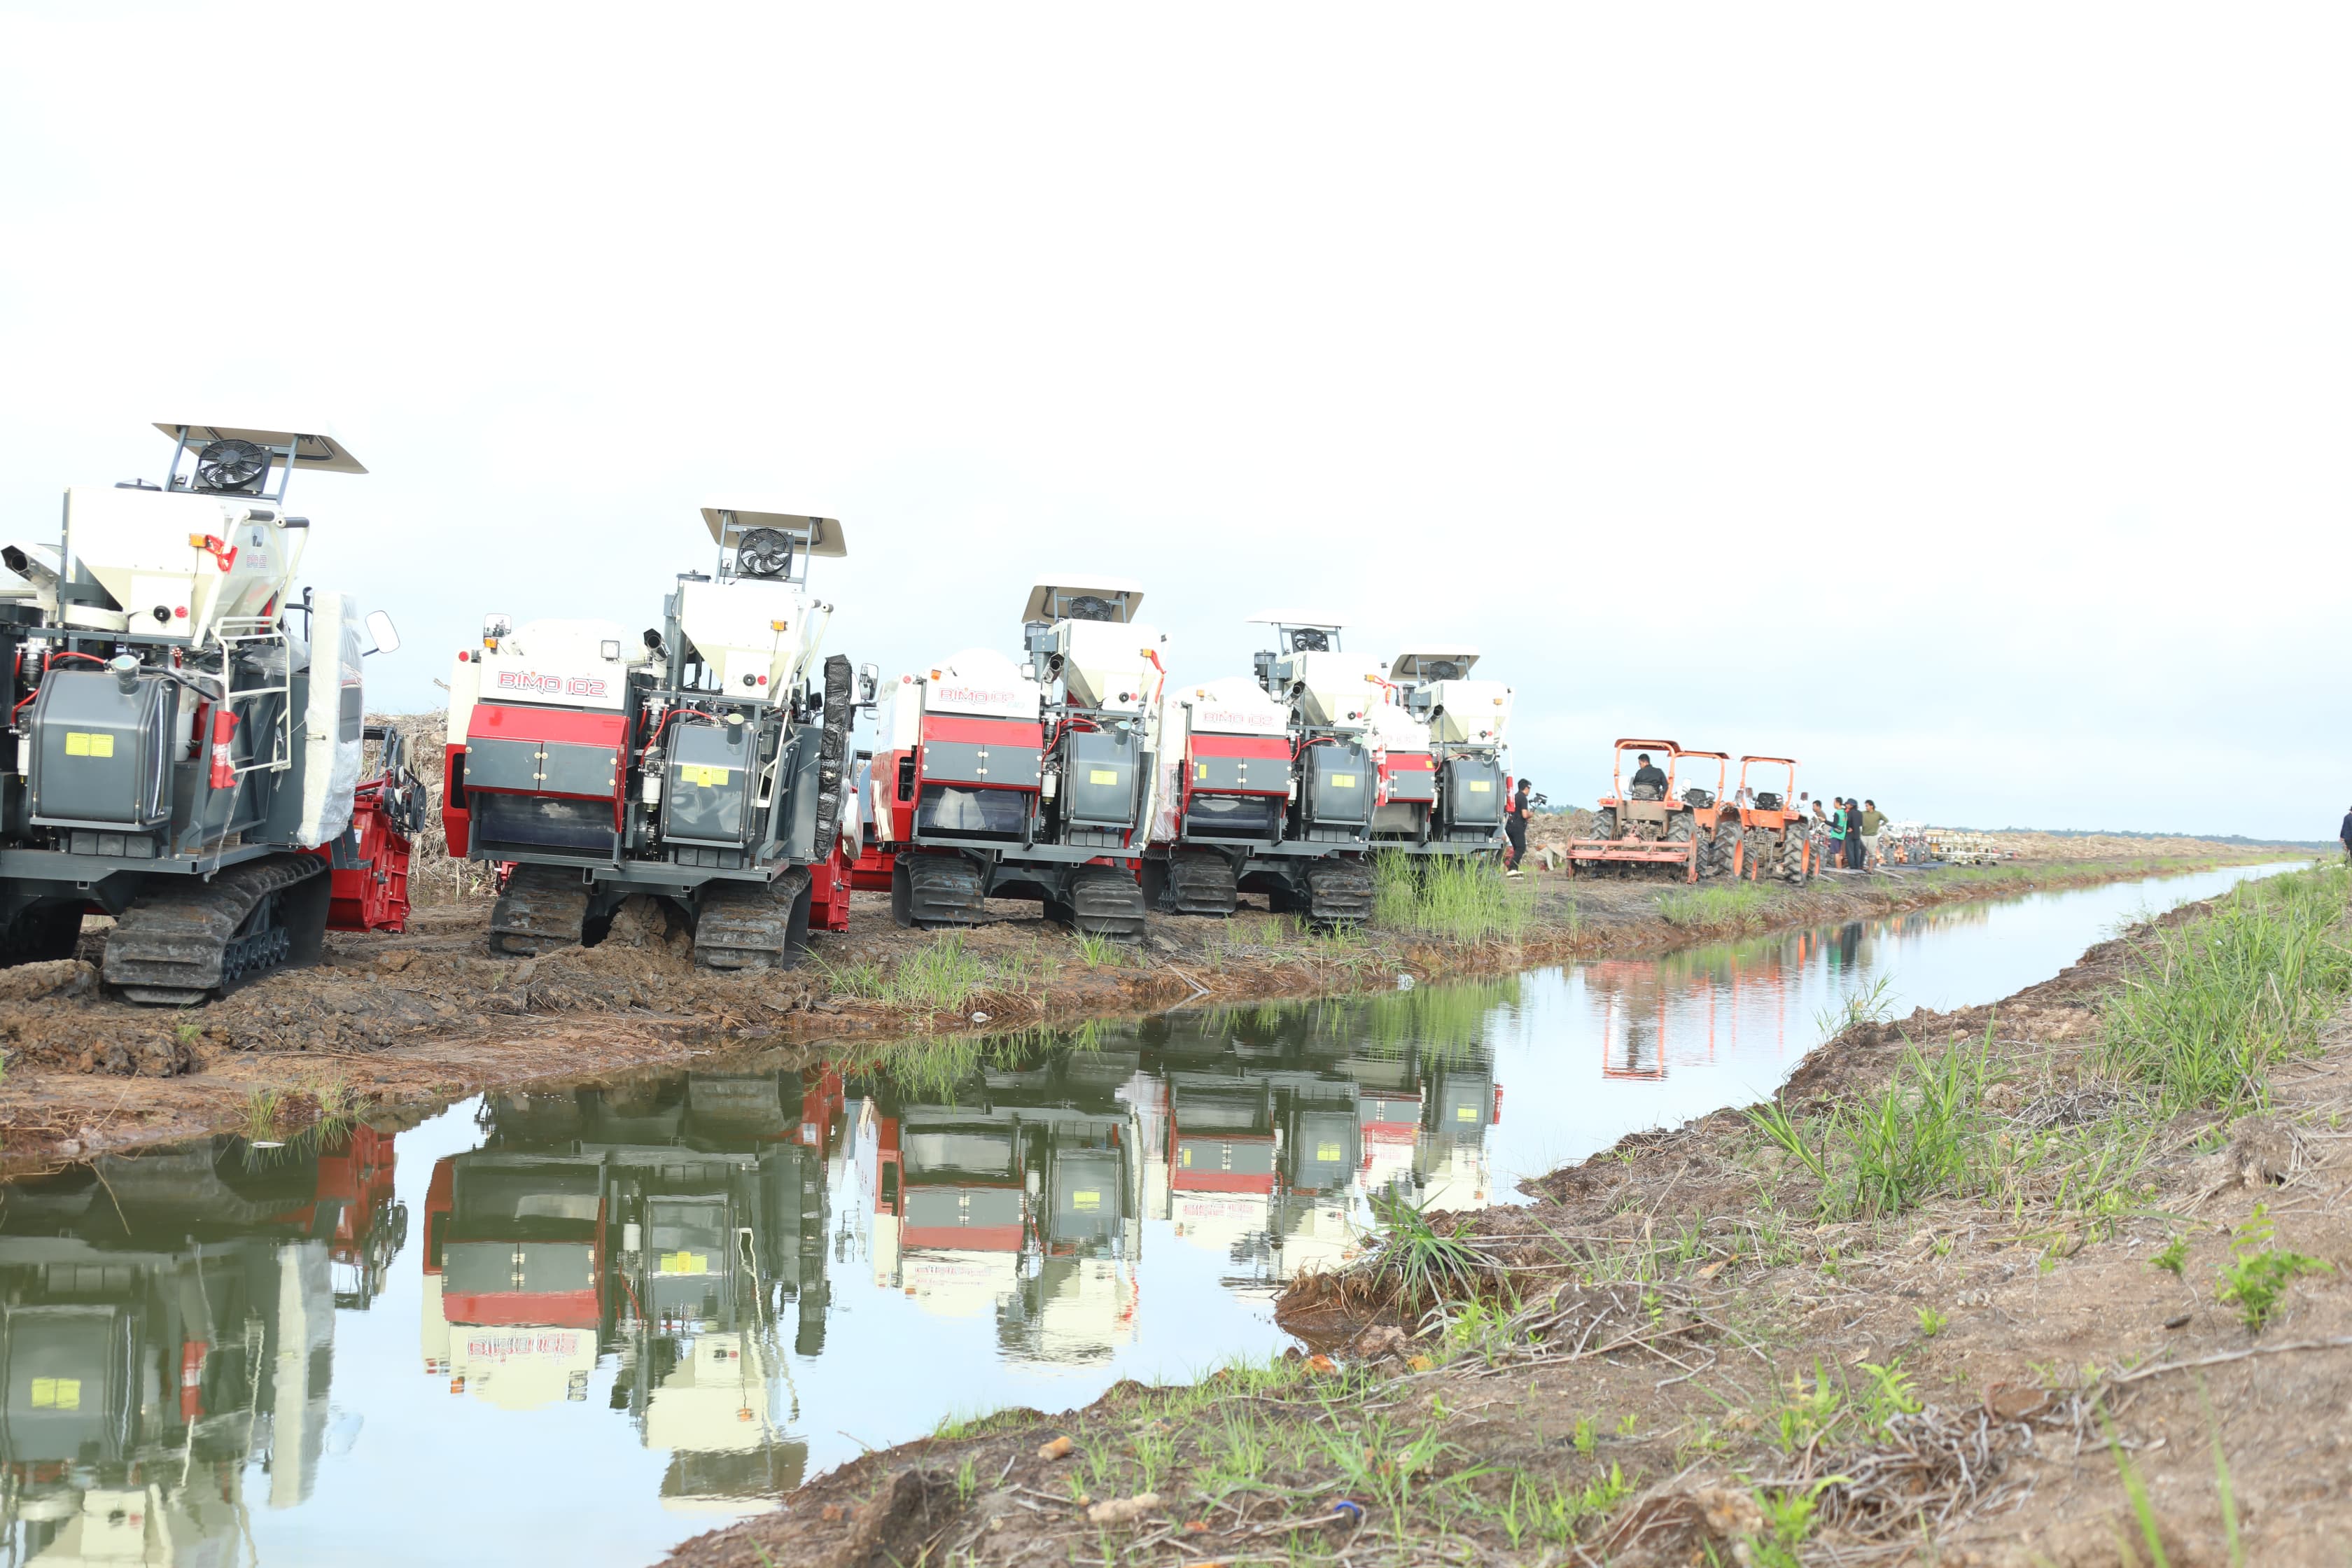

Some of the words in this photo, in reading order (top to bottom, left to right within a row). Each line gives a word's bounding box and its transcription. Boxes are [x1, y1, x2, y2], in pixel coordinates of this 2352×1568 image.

[498, 671, 562, 694] BIMO
[566, 677, 608, 698] 102
[939, 687, 988, 706] BIMO
[1203, 711, 1244, 724] BIMO
